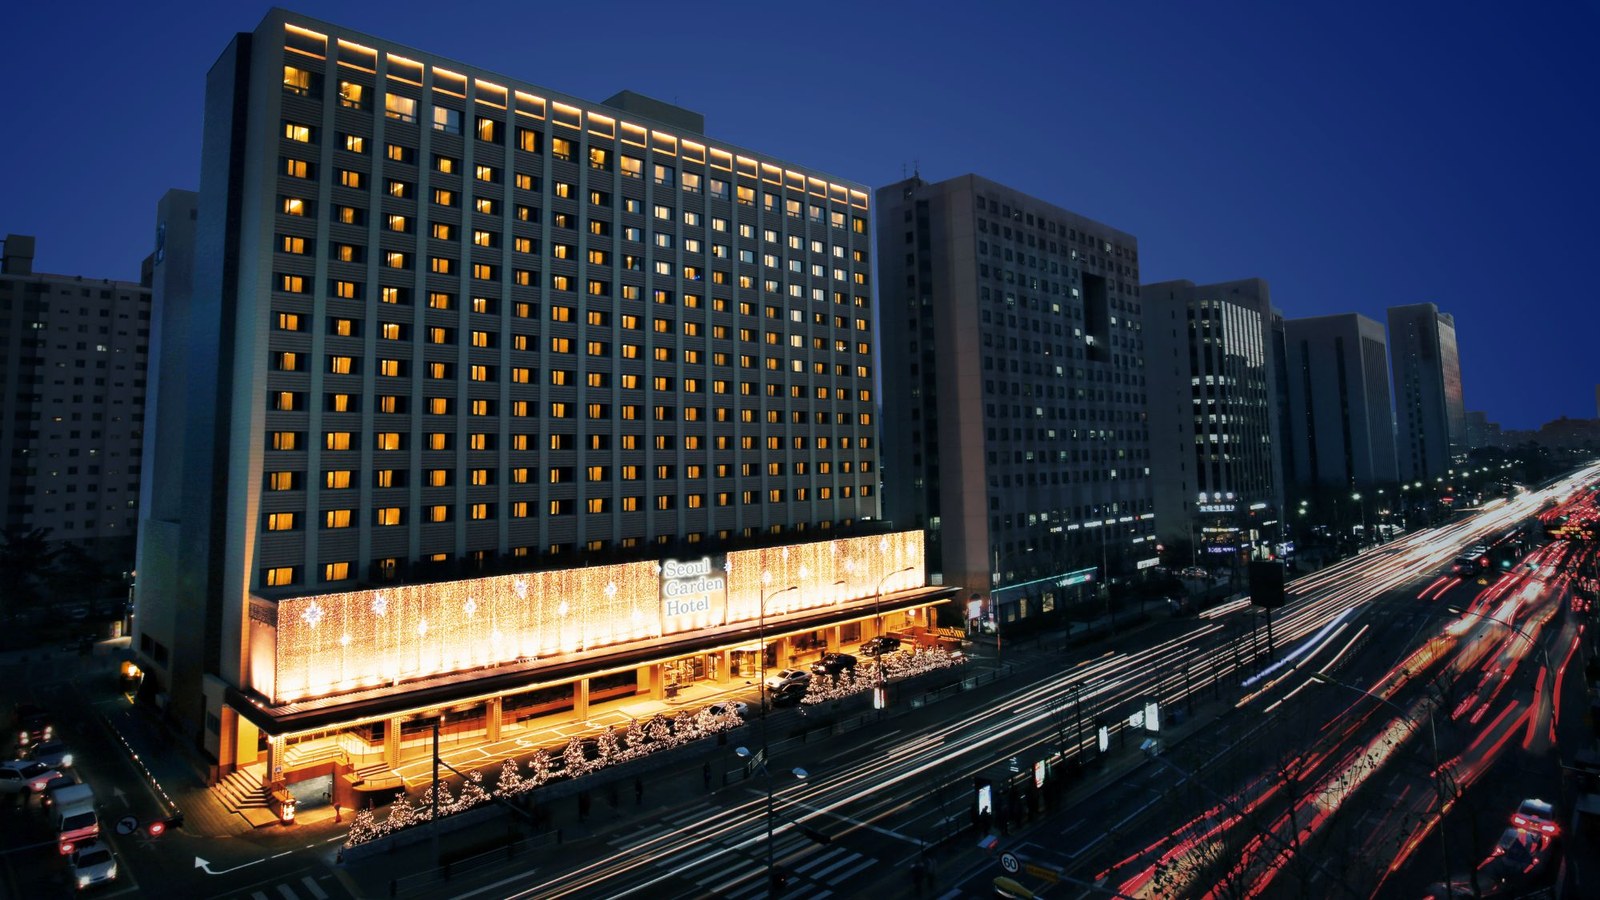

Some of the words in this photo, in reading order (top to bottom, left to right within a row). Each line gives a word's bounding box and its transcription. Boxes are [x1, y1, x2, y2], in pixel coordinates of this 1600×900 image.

[665, 559, 709, 577] Seoul
[666, 578, 723, 597] Garden
[667, 596, 709, 616] Hotel
[1003, 856, 1017, 870] 60
